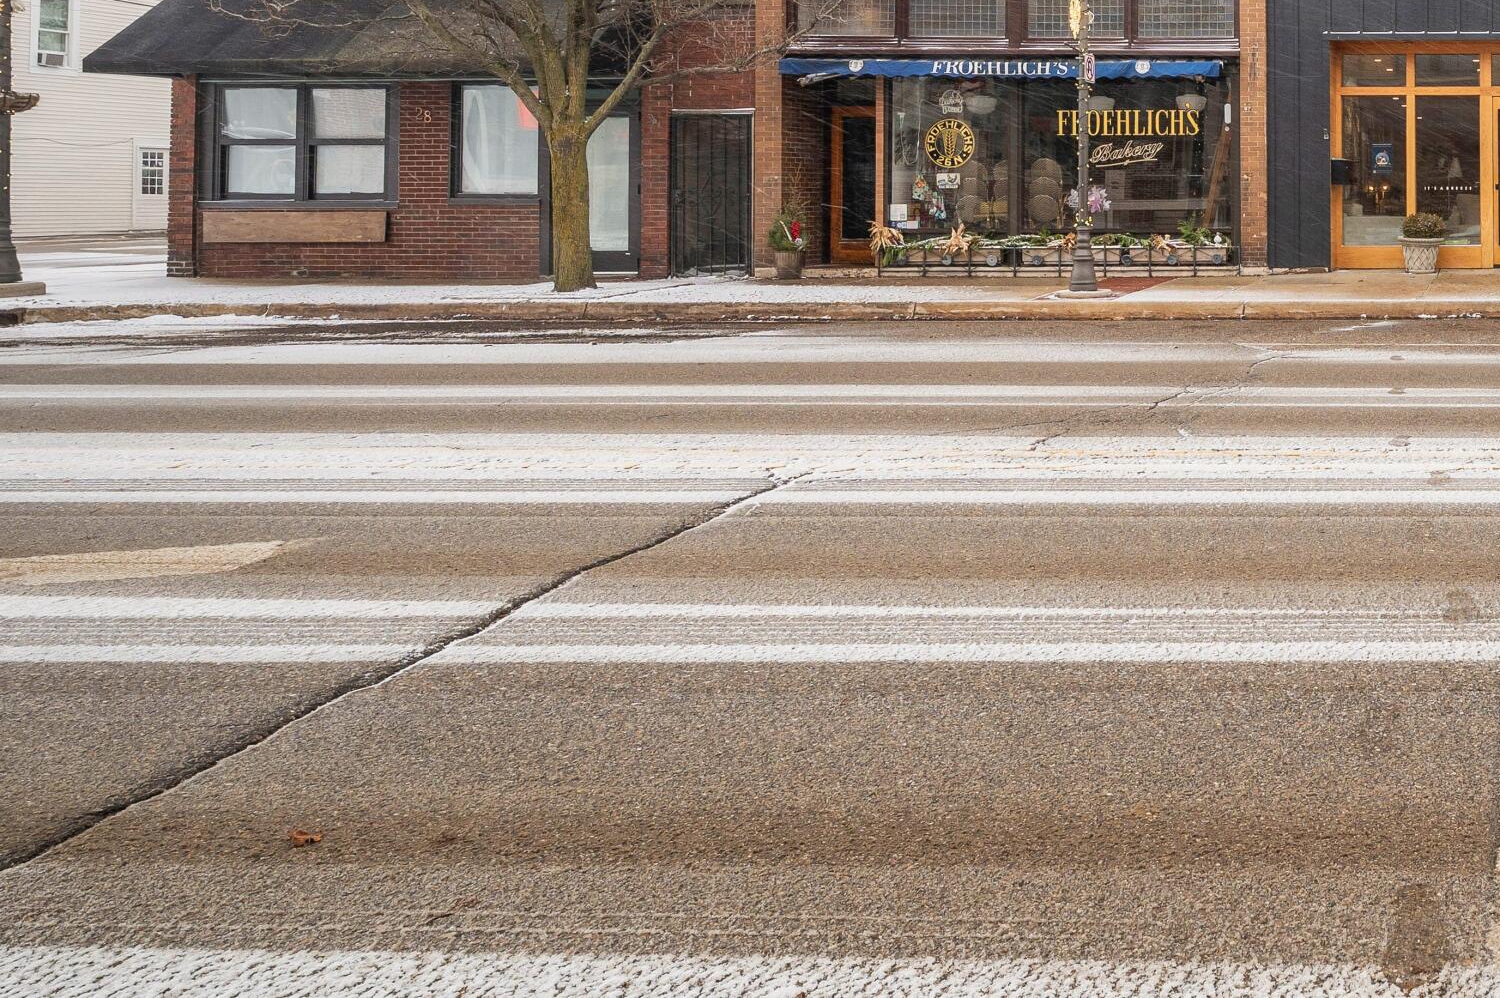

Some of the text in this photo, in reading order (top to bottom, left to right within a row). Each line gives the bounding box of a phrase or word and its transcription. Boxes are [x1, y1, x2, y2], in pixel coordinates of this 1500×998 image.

[930, 60, 1069, 76] FROEHLICH'S
[415, 107, 432, 123] 28
[1089, 140, 1164, 164] Bakery
[937, 156, 952, 166] 26
